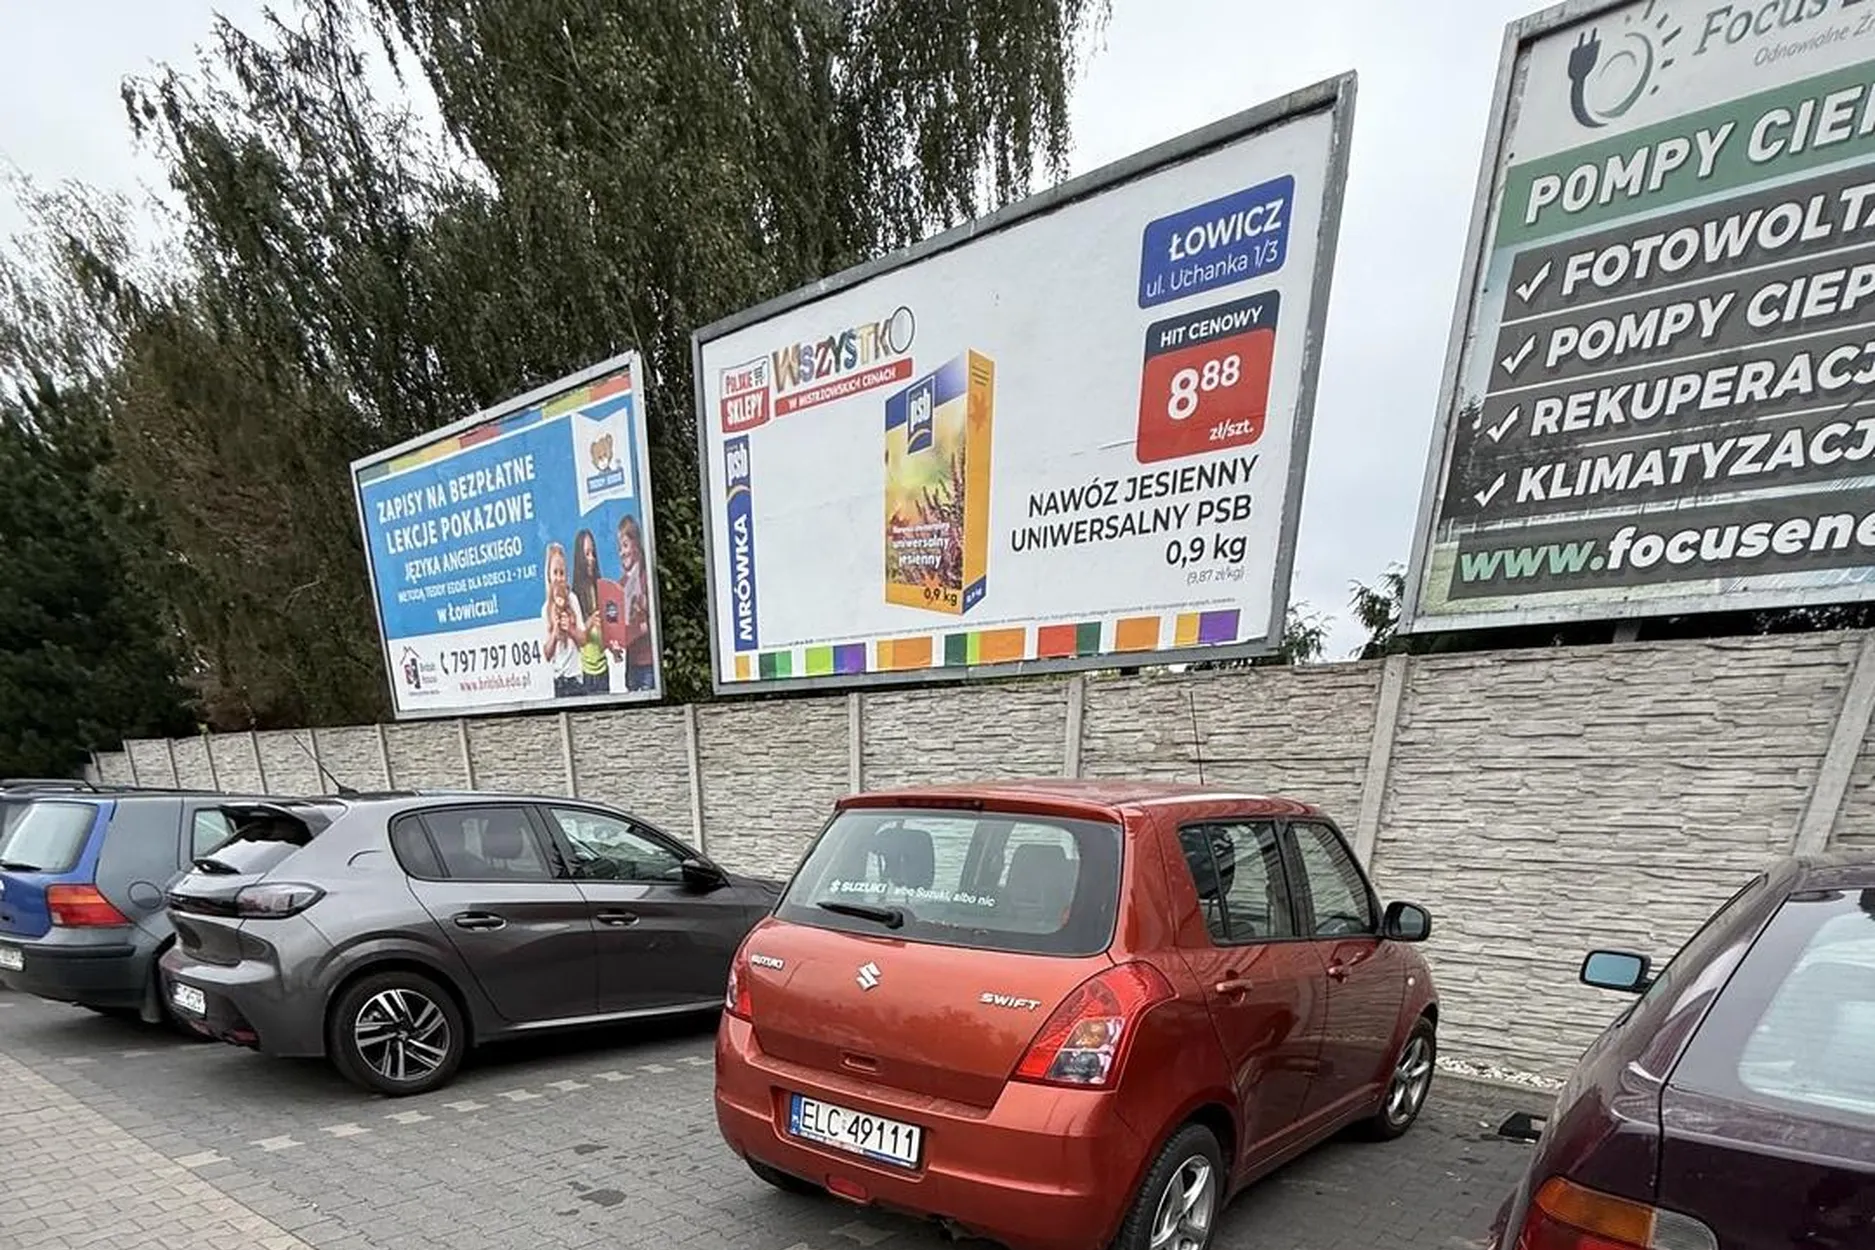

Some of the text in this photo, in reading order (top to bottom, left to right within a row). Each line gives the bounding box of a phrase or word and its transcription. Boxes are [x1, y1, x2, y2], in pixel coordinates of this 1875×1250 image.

[1754, 25, 1849, 66] Odnowialne
[1525, 83, 1875, 224] POMPY CIE
[1168, 198, 1284, 262] ŁOWICZ
[1561, 182, 1875, 297] FOTOWOLT
[1146, 239, 1278, 298] ul. Uchanka 1/3
[1160, 305, 1263, 348] HIT CENOWY
[1545, 262, 1875, 368] POMPY CIEP
[727, 391, 763, 427] SKLEPY
[1209, 418, 1254, 441] zł/szt.
[376, 454, 536, 525] ZAPISY NA BEZPŁATNE
[1029, 454, 1260, 518] NAWÓZ JESIENNY
[386, 492, 534, 555] LEKCJE POKAZOWE
[1011, 494, 1252, 552] UNIWERSALNY PSB
[404, 536, 522, 584] JĘZYKA ANGIELSKIEGO
[1166, 533, 1248, 568] 0,9 kg
[734, 513, 753, 641] MRÓWKA
[923, 587, 940, 607] 0,9
[943, 587, 958, 606] kg
[437, 593, 499, 624] w Łowiczu!
[451, 640, 542, 673] 797 797 084
[841, 881, 888, 894] SUZUKI
[952, 891, 976, 904] albo
[977, 894, 996, 907] nic
[979, 992, 1041, 1012] SWIFT
[801, 1101, 841, 1137] ELC
[847, 1115, 914, 1158] 49111
